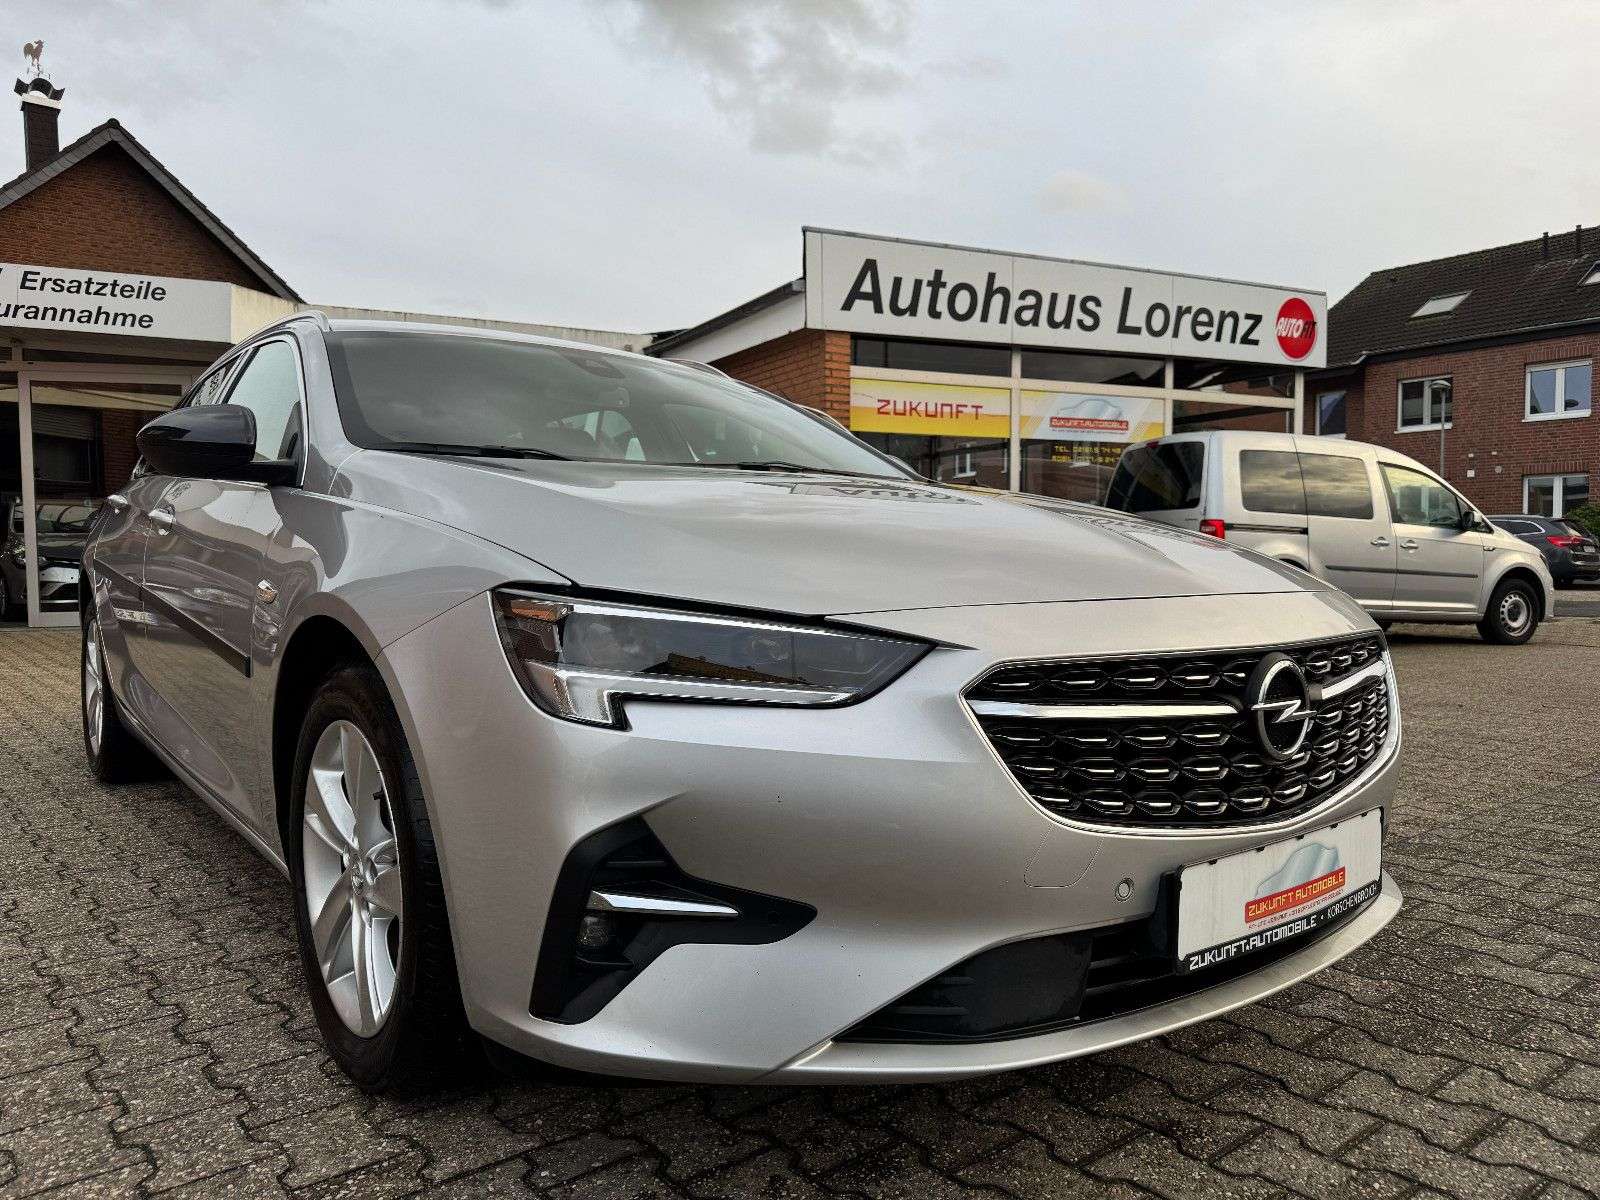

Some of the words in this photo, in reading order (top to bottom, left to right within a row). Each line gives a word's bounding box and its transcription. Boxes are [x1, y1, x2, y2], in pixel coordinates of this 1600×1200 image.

[19, 270, 167, 301] Ersatzteile
[840, 258, 1102, 332] Autohaus
[1117, 287, 1263, 346] Lorenz
[877, 399, 984, 420] ZUKUNFT
